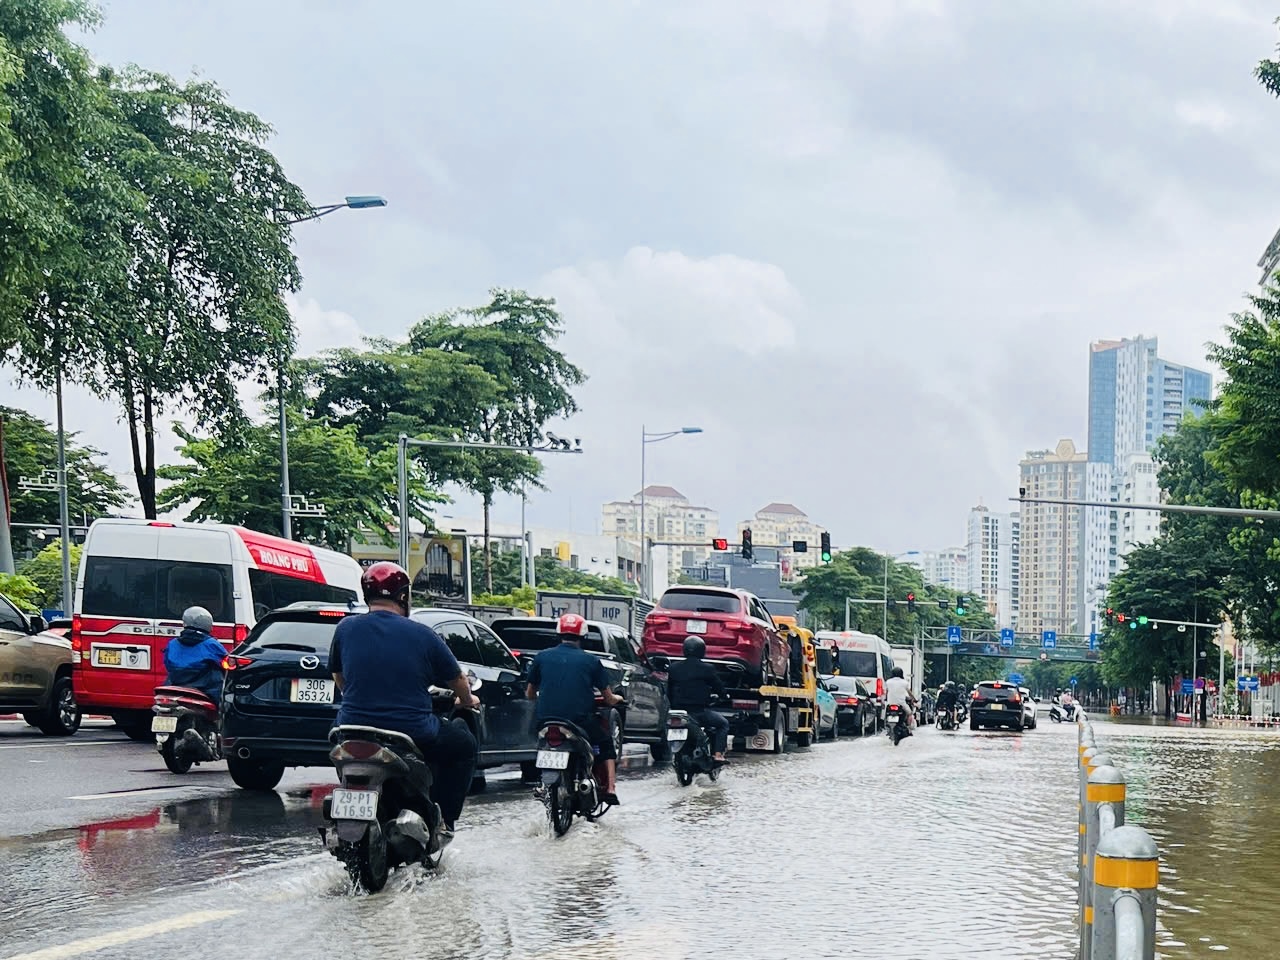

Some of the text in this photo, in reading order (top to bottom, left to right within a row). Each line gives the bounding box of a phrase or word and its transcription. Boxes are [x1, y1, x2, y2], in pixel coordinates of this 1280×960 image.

[602, 606, 621, 620] HỢP
[133, 626, 177, 636] DCAR
[306, 679, 326, 690] 30G
[298, 690, 331, 702] 353.24
[339, 792, 371, 805] 29-P1
[334, 804, 374, 818] 416.95
